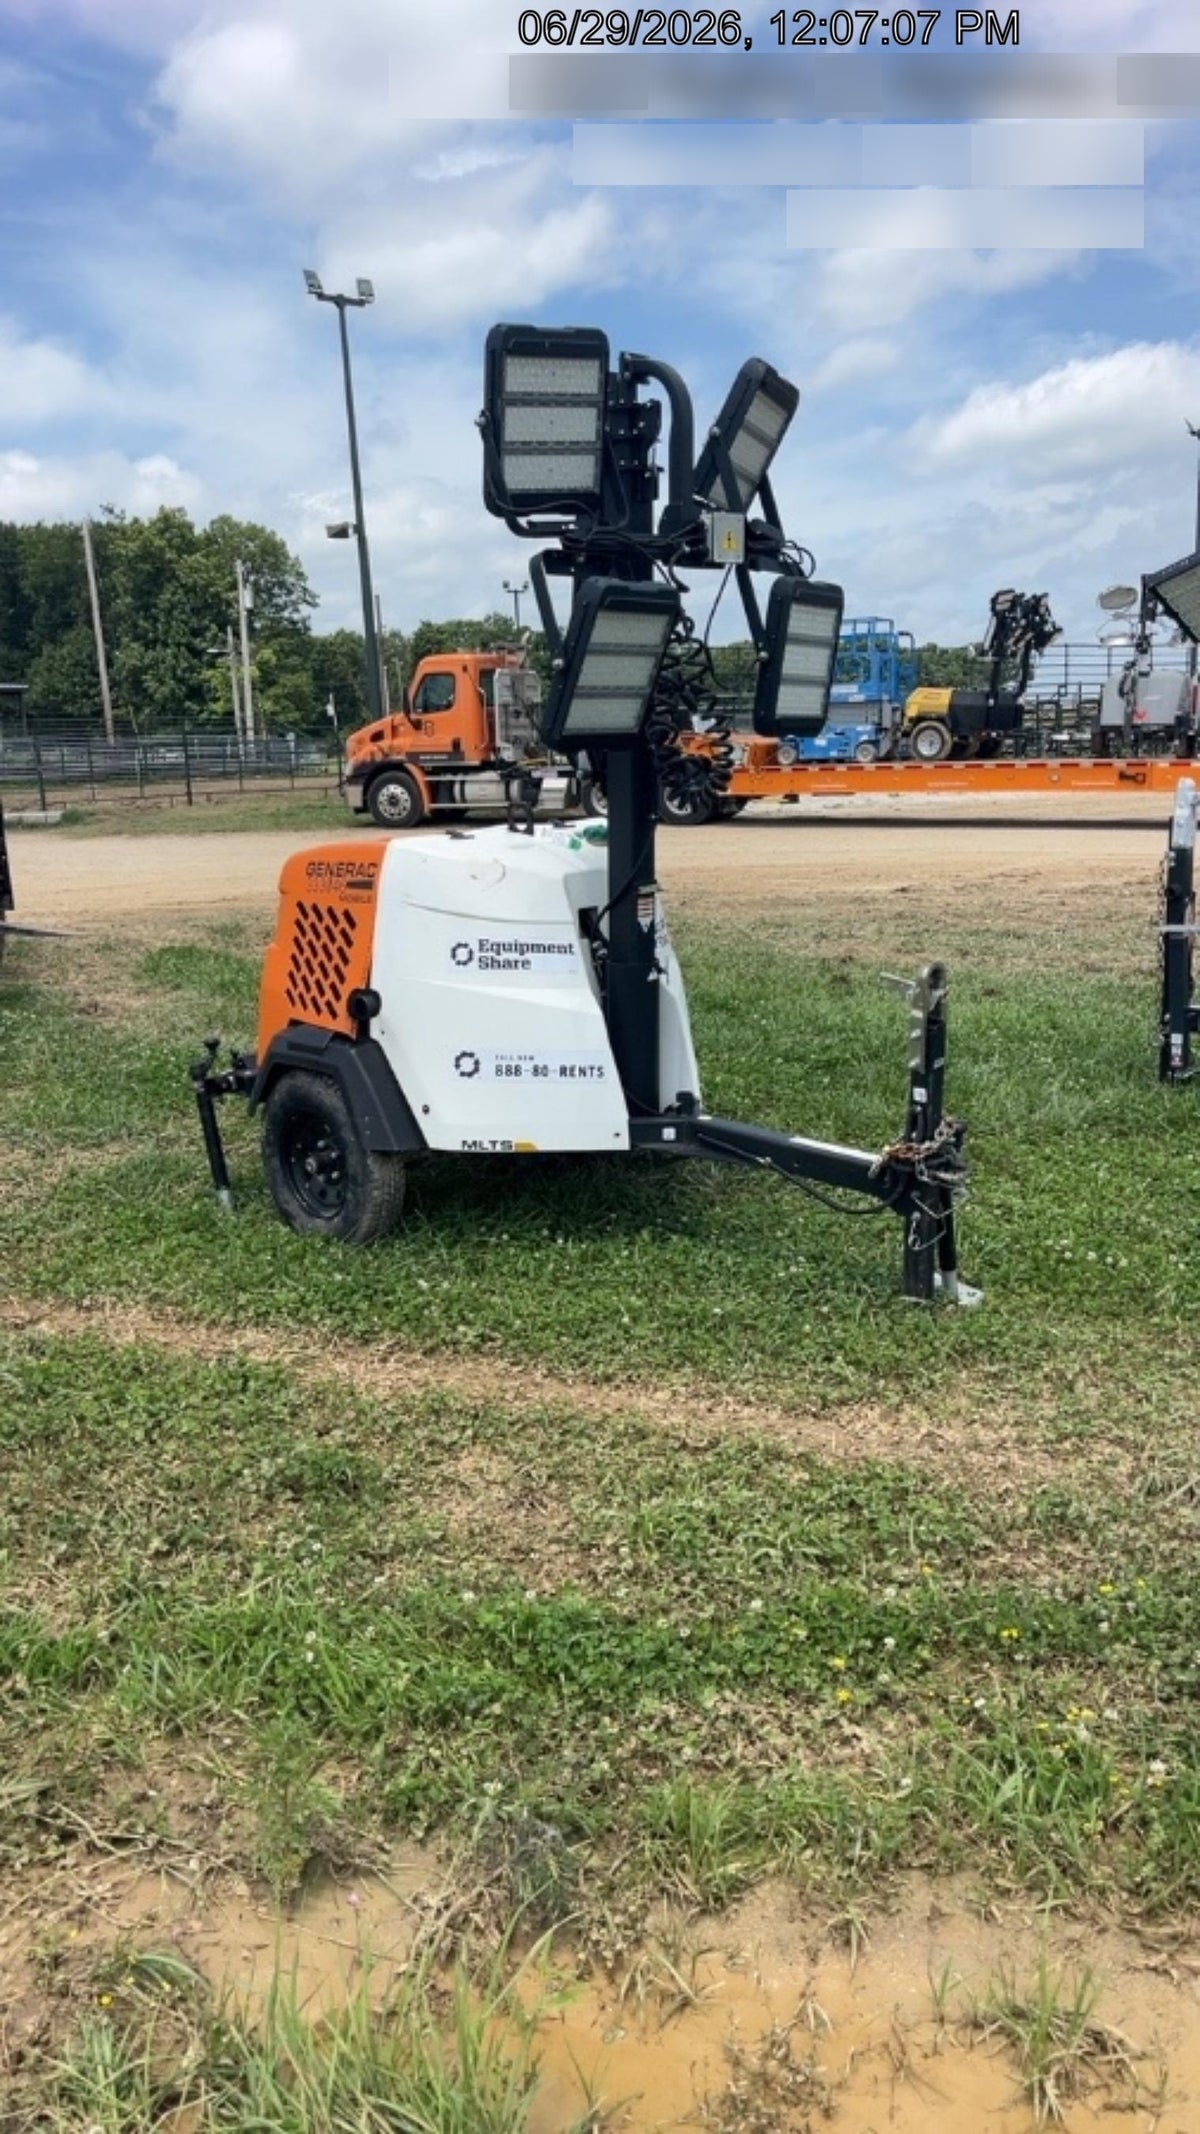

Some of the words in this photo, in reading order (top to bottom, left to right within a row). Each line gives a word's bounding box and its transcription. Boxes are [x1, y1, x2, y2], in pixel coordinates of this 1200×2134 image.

[306, 862, 377, 878] GENERAC
[478, 938, 575, 956] Equipment
[478, 956, 532, 970] Share
[495, 1064, 605, 1079] 888-80-RENTS
